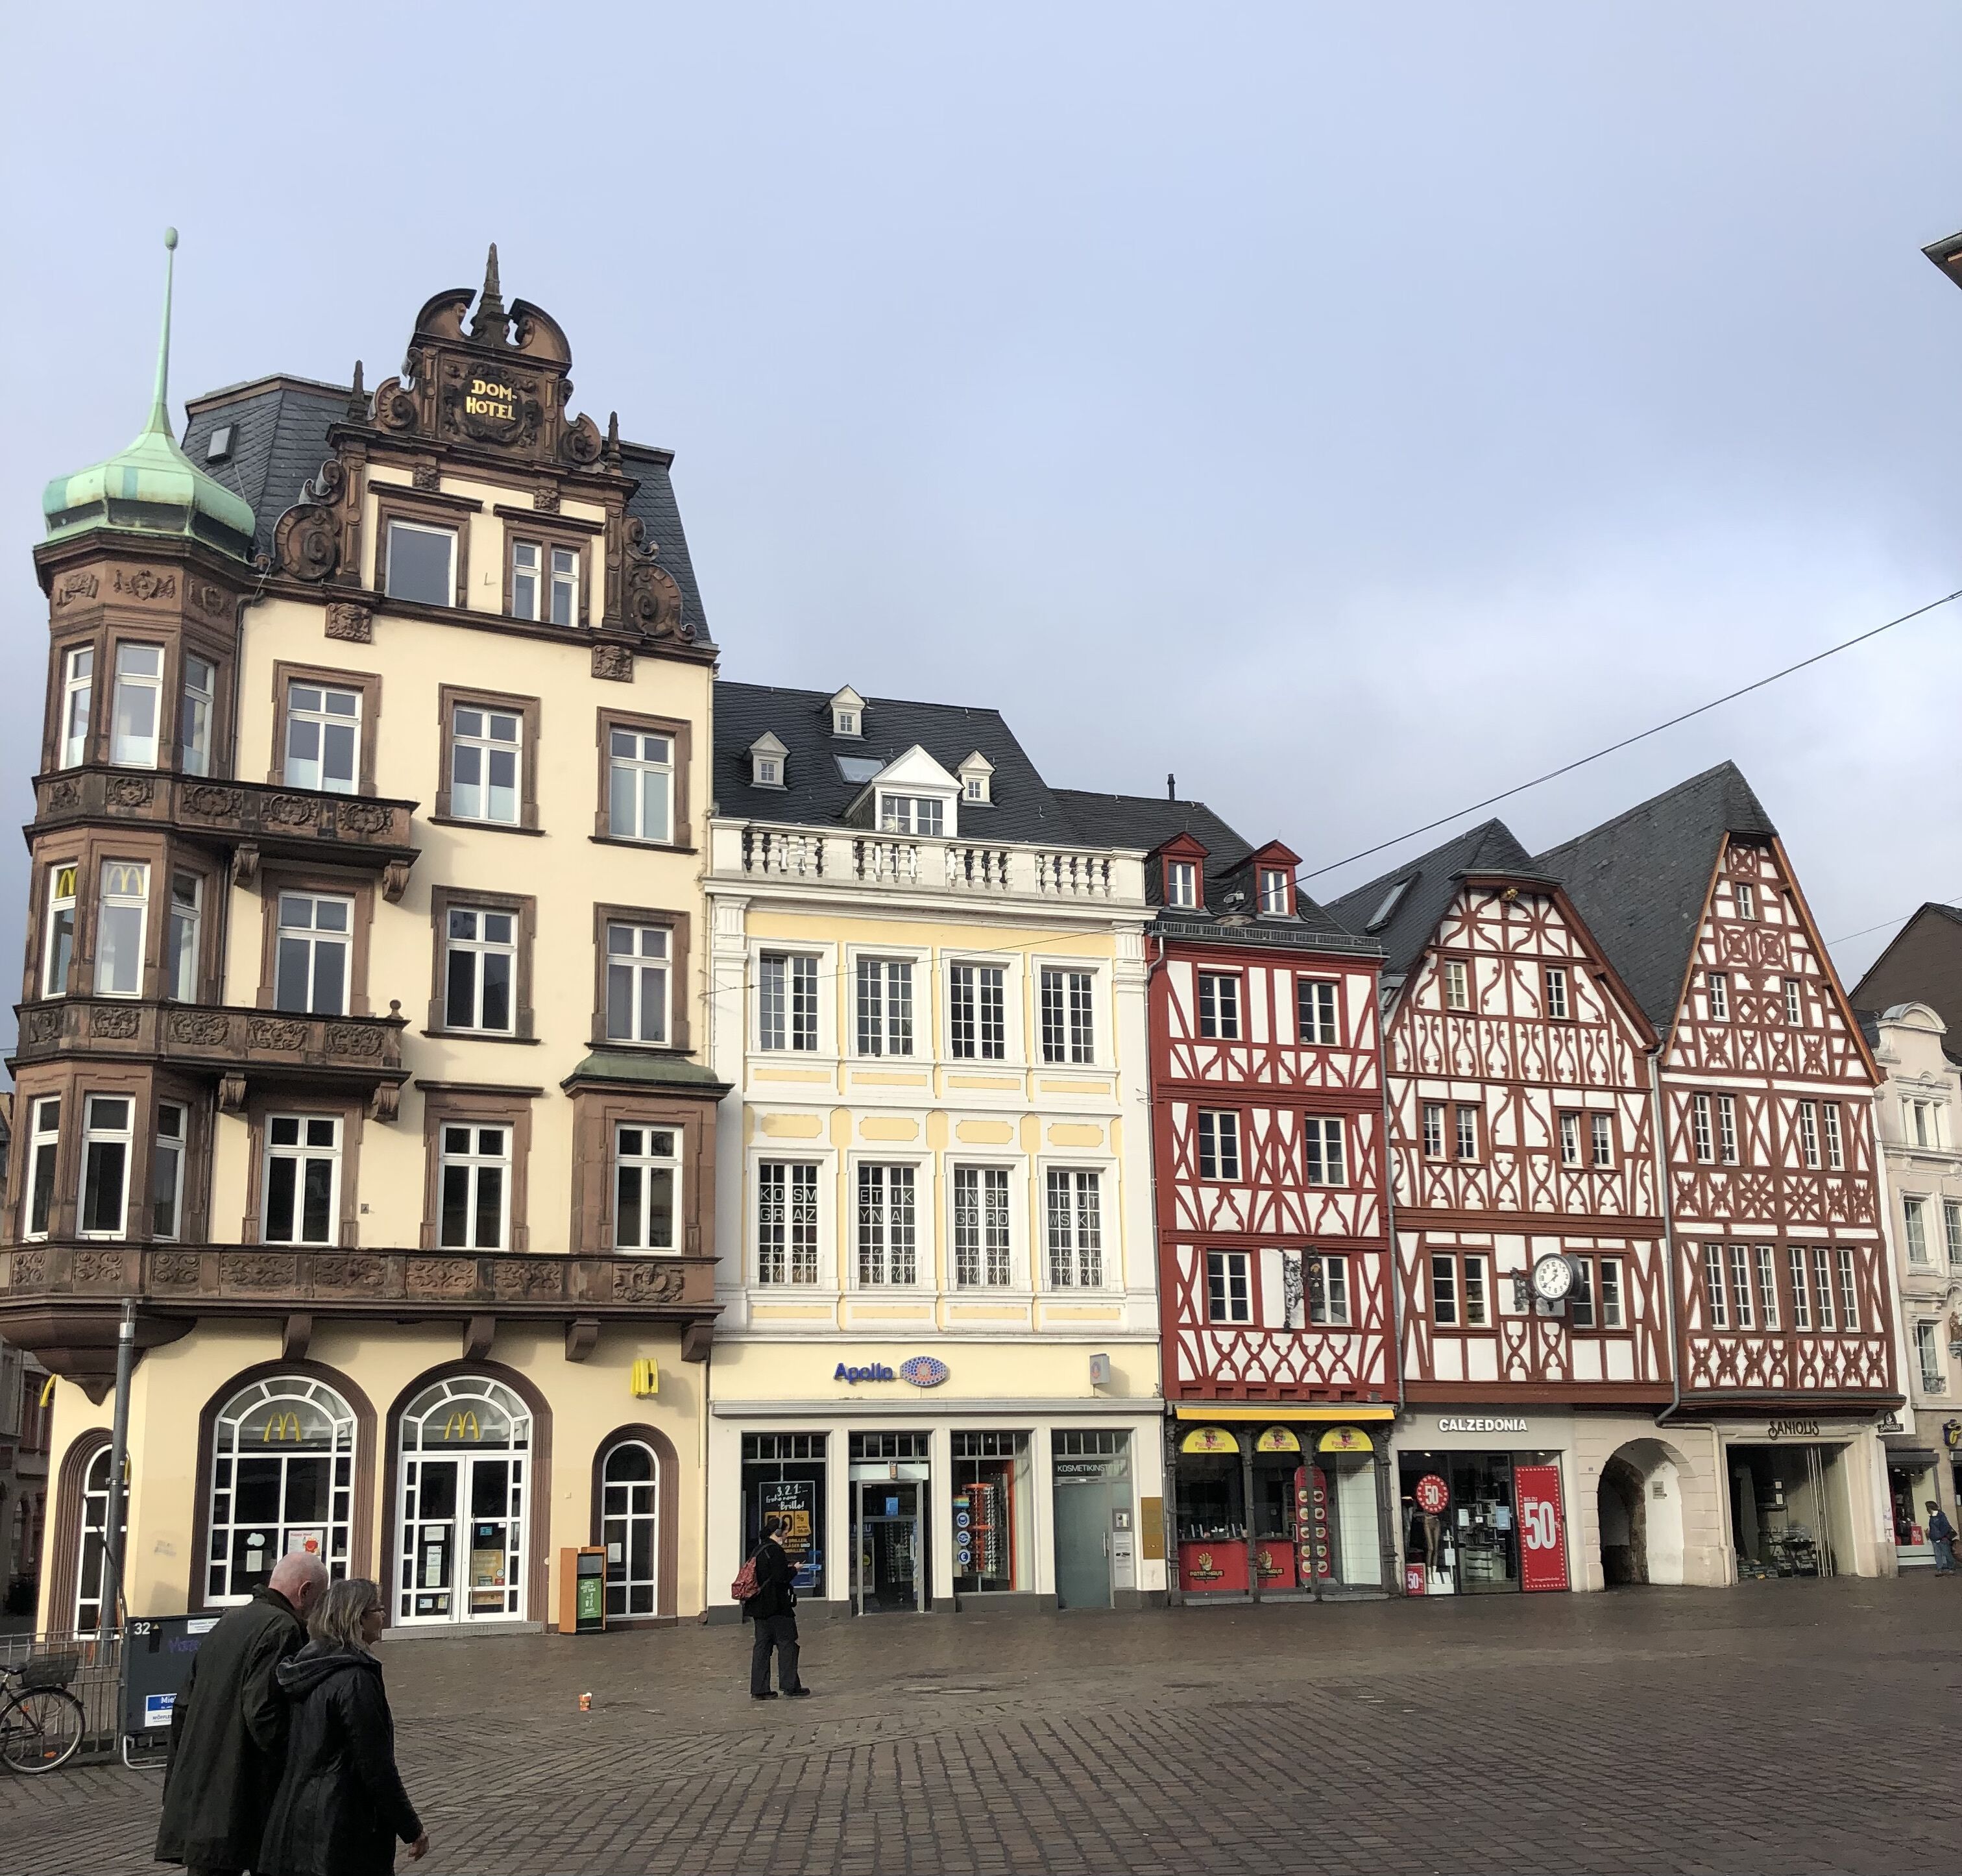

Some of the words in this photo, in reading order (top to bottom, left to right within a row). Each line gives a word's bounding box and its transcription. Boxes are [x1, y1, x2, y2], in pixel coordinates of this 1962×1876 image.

[471, 379, 517, 401] DOM-
[466, 396, 516, 421] HOTEL
[834, 1362, 893, 1385] Apollo
[1438, 1419, 1529, 1431] CALZEDONIA
[134, 1622, 151, 1635] 32
